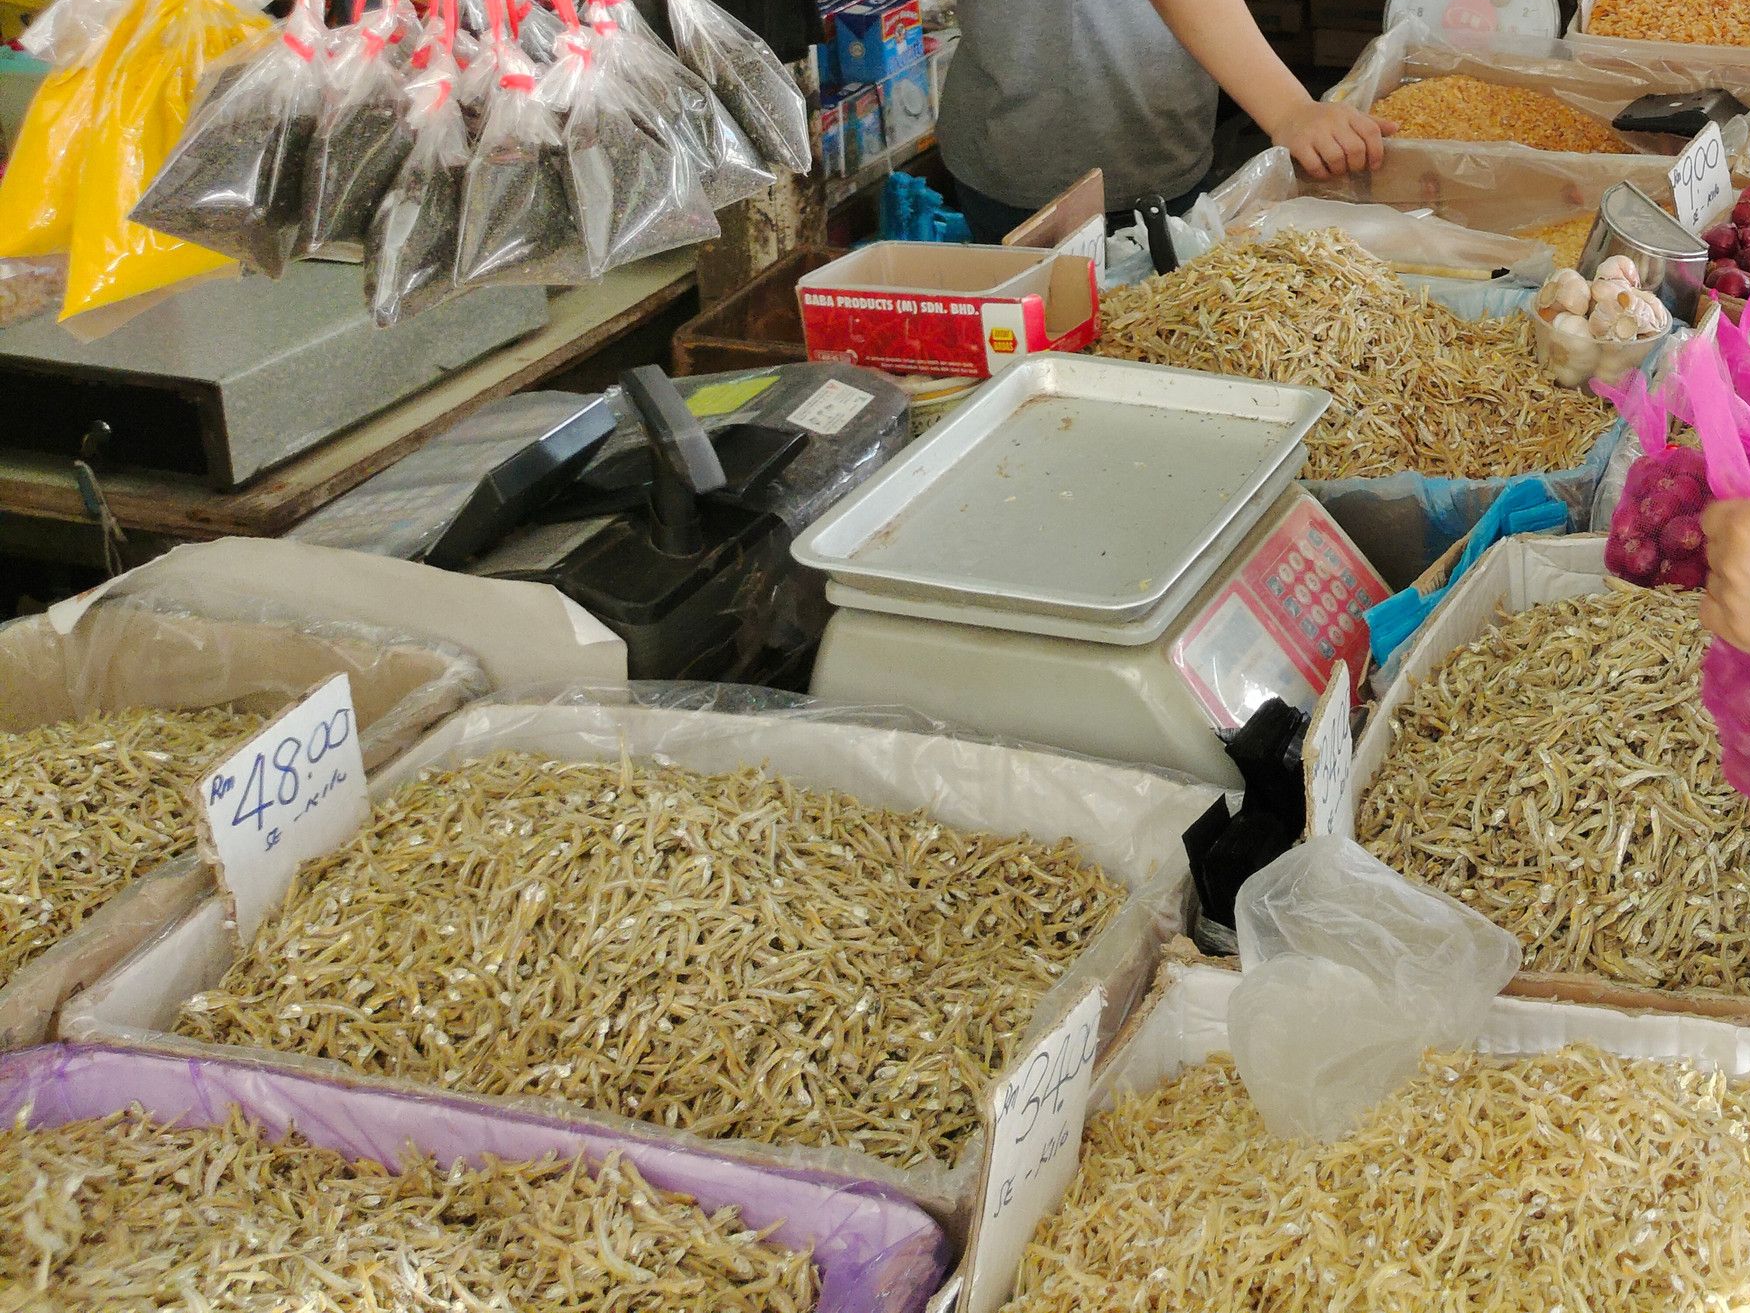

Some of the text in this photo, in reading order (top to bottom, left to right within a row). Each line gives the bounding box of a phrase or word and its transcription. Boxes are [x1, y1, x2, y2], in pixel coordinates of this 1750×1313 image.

[1682, 139, 1719, 210] 9.00
[804, 293, 980, 316] BABA PRODUCTS (M) SDN. BHD.
[231, 708, 350, 831] 48.00
